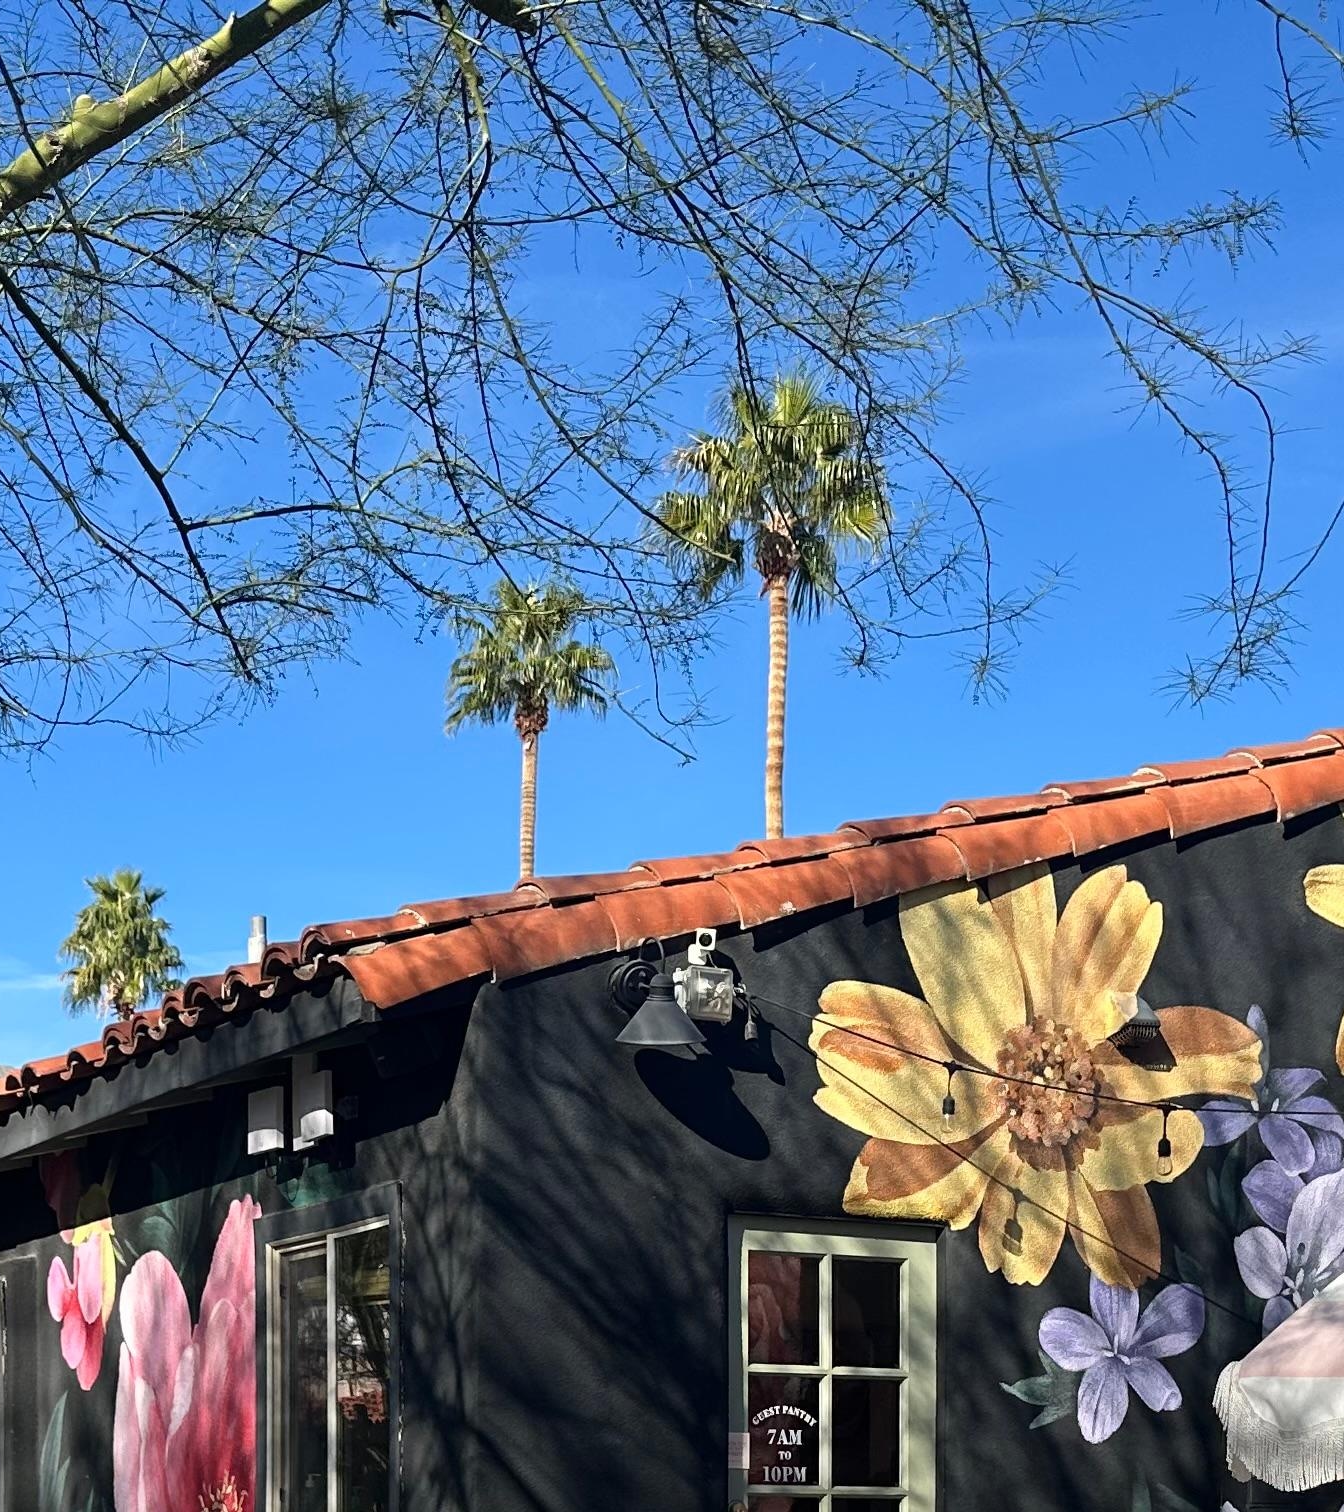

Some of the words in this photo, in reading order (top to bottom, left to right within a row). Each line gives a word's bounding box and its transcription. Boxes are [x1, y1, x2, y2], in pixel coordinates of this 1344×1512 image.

[752, 1405, 781, 1425] GUEST
[782, 1405, 818, 1427] PANTRY
[766, 1428, 803, 1446] 7AM
[777, 1450, 792, 1461] TO
[762, 1465, 808, 1483] 10PM
